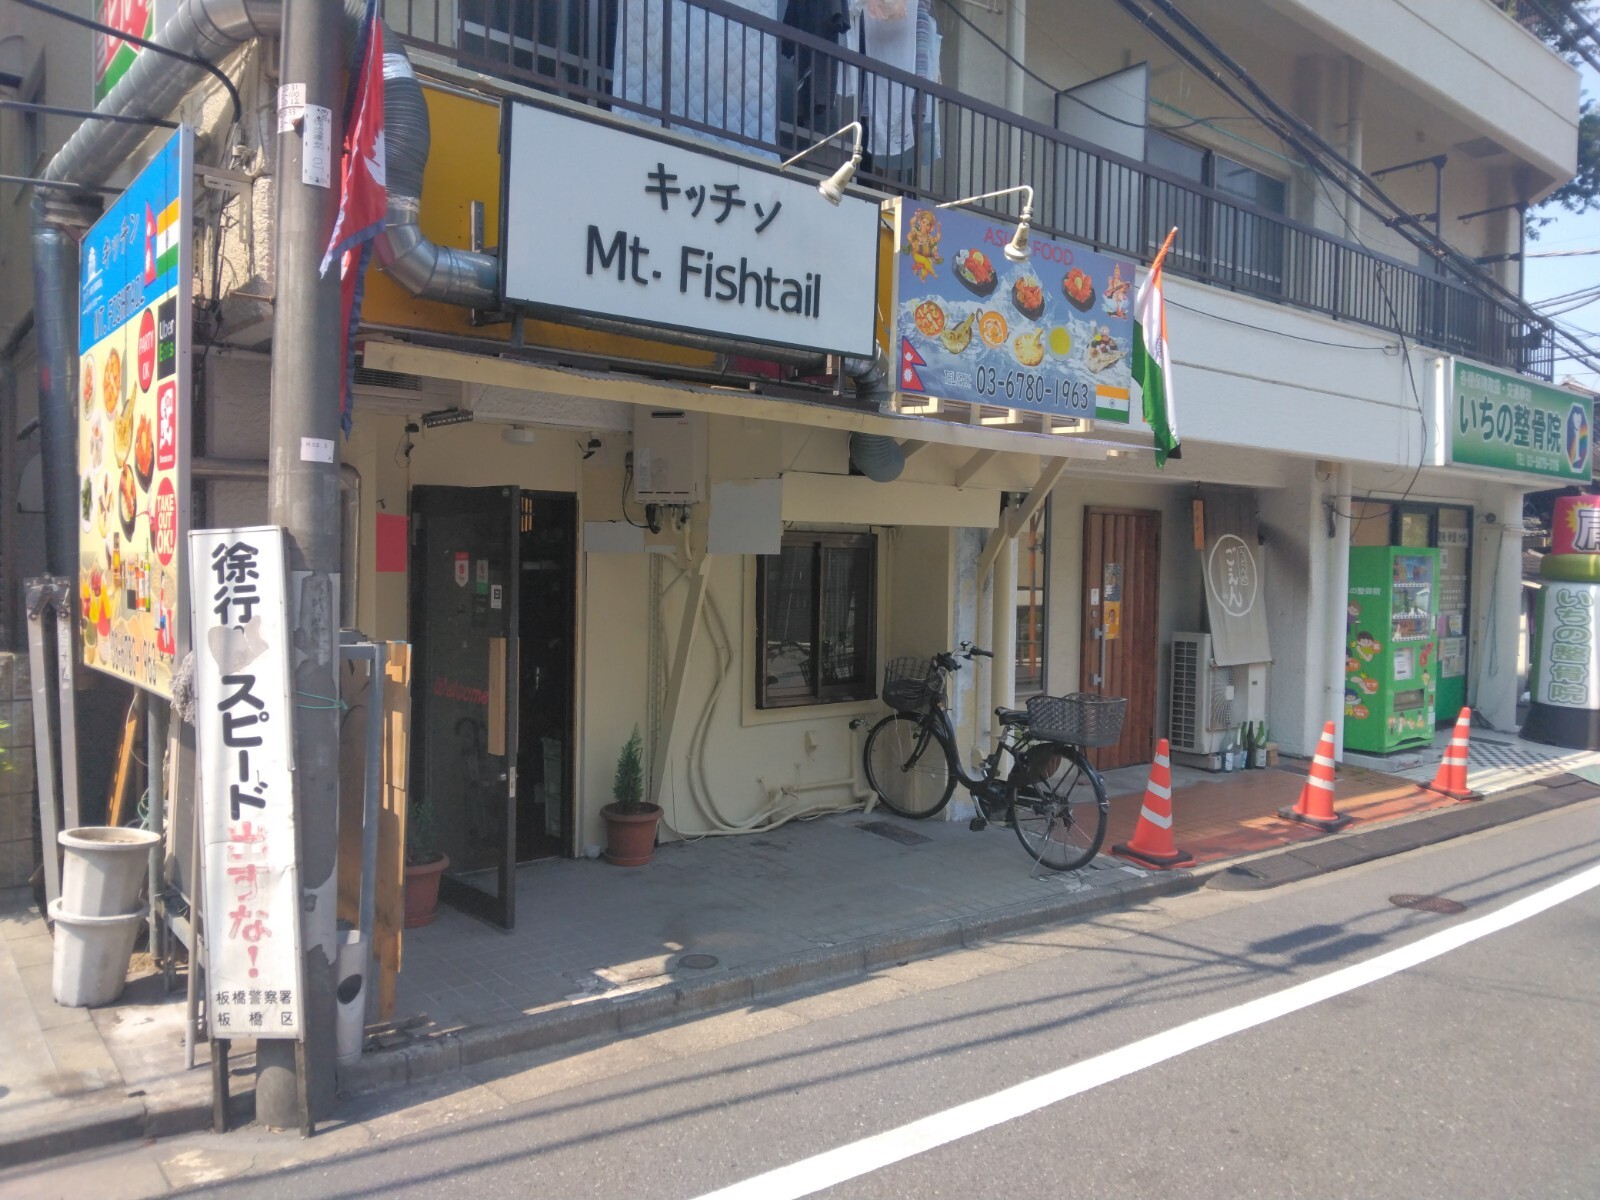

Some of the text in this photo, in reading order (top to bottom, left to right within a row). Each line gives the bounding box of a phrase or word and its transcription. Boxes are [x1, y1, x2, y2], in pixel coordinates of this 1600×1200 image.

[645, 163, 782, 233] キッチン
[1033, 241, 1074, 266] FOOD
[586, 224, 821, 318] Mt. Fishtail
[159, 318, 175, 340] Uber
[138, 329, 155, 356] PARTY
[142, 361, 150, 381] OK
[976, 365, 1088, 409] 03-6780-1963
[1459, 394, 1562, 453] いちの整骨院
[157, 494, 174, 511] TAKE
[158, 511, 172, 529] OUT
[157, 529, 173, 554] OK!
[1549, 589, 1593, 705] いちの整骨院
[216, 989, 292, 1006] 板橋警察署
[217, 1011, 293, 1027] 板橋区
